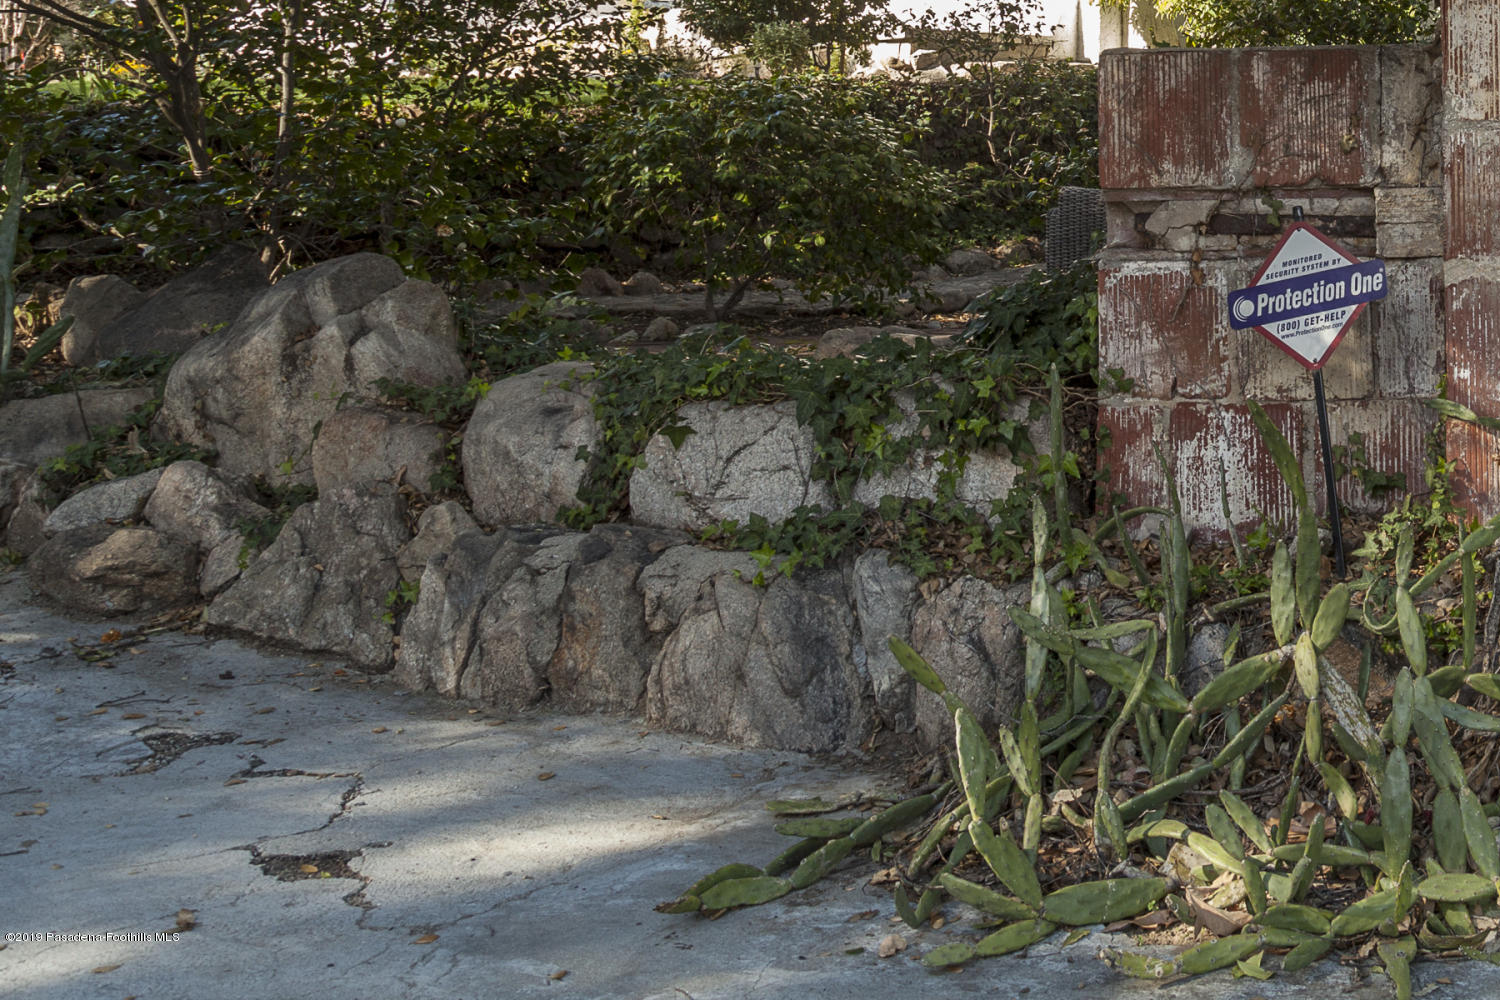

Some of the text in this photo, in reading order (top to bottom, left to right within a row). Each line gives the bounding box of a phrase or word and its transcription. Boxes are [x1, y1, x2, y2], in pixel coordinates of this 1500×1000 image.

[1265, 257, 1342, 281] SECURITY SYSTEM BY
[1282, 253, 1322, 268] MONITORED
[1257, 280, 1346, 317] Protection
[1276, 310, 1347, 335] (800) GET-HELP
[1280, 323, 1344, 340] www.ProtectionOne.com
